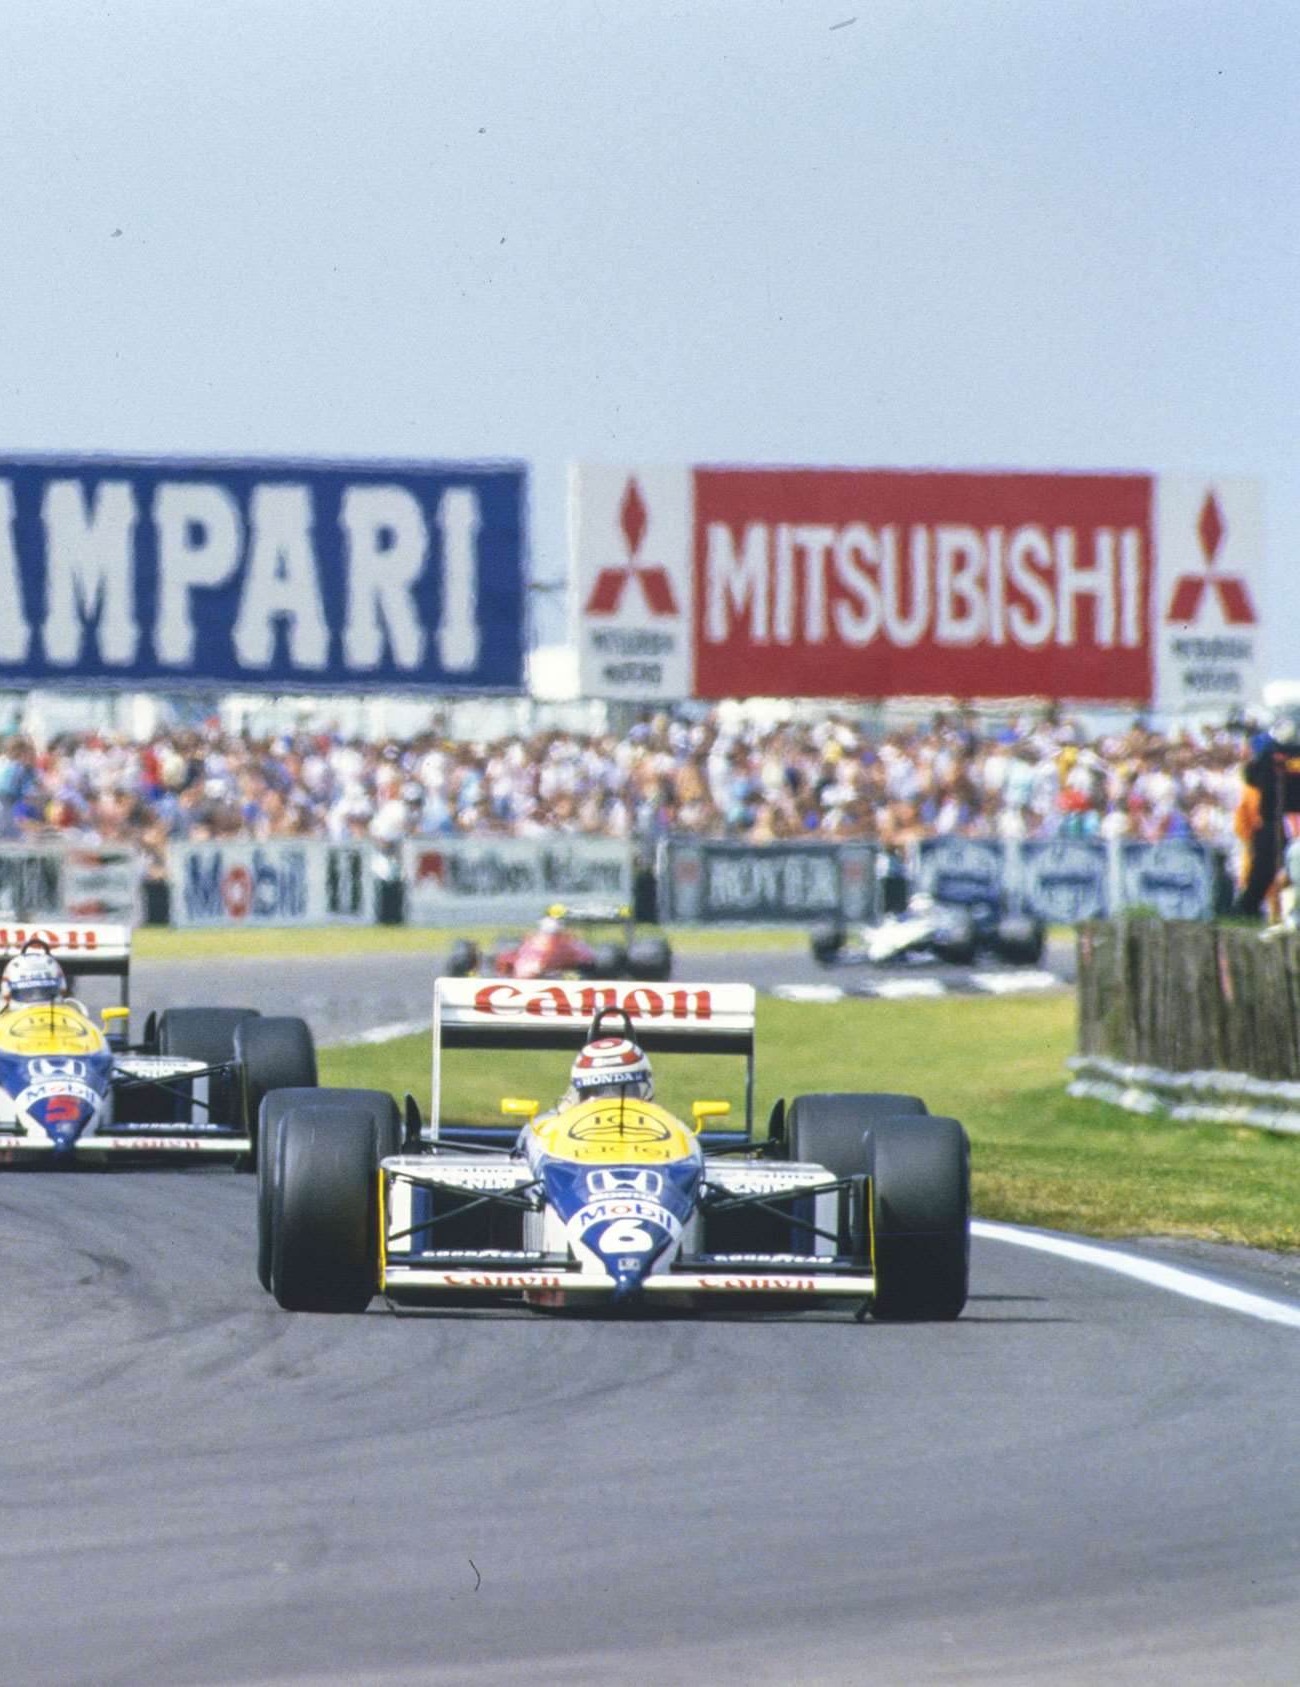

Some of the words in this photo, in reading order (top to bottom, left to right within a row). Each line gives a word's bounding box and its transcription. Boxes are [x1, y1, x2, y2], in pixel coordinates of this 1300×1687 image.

[705, 520, 1144, 649] MITSUBISHI
[184, 850, 307, 918] Mobil
[473, 984, 712, 1021] Canon
[582, 1072, 634, 1087] HONDA
[45, 1094, 82, 1123] 5
[579, 1203, 673, 1230] Mobil
[598, 1218, 654, 1254] 6
